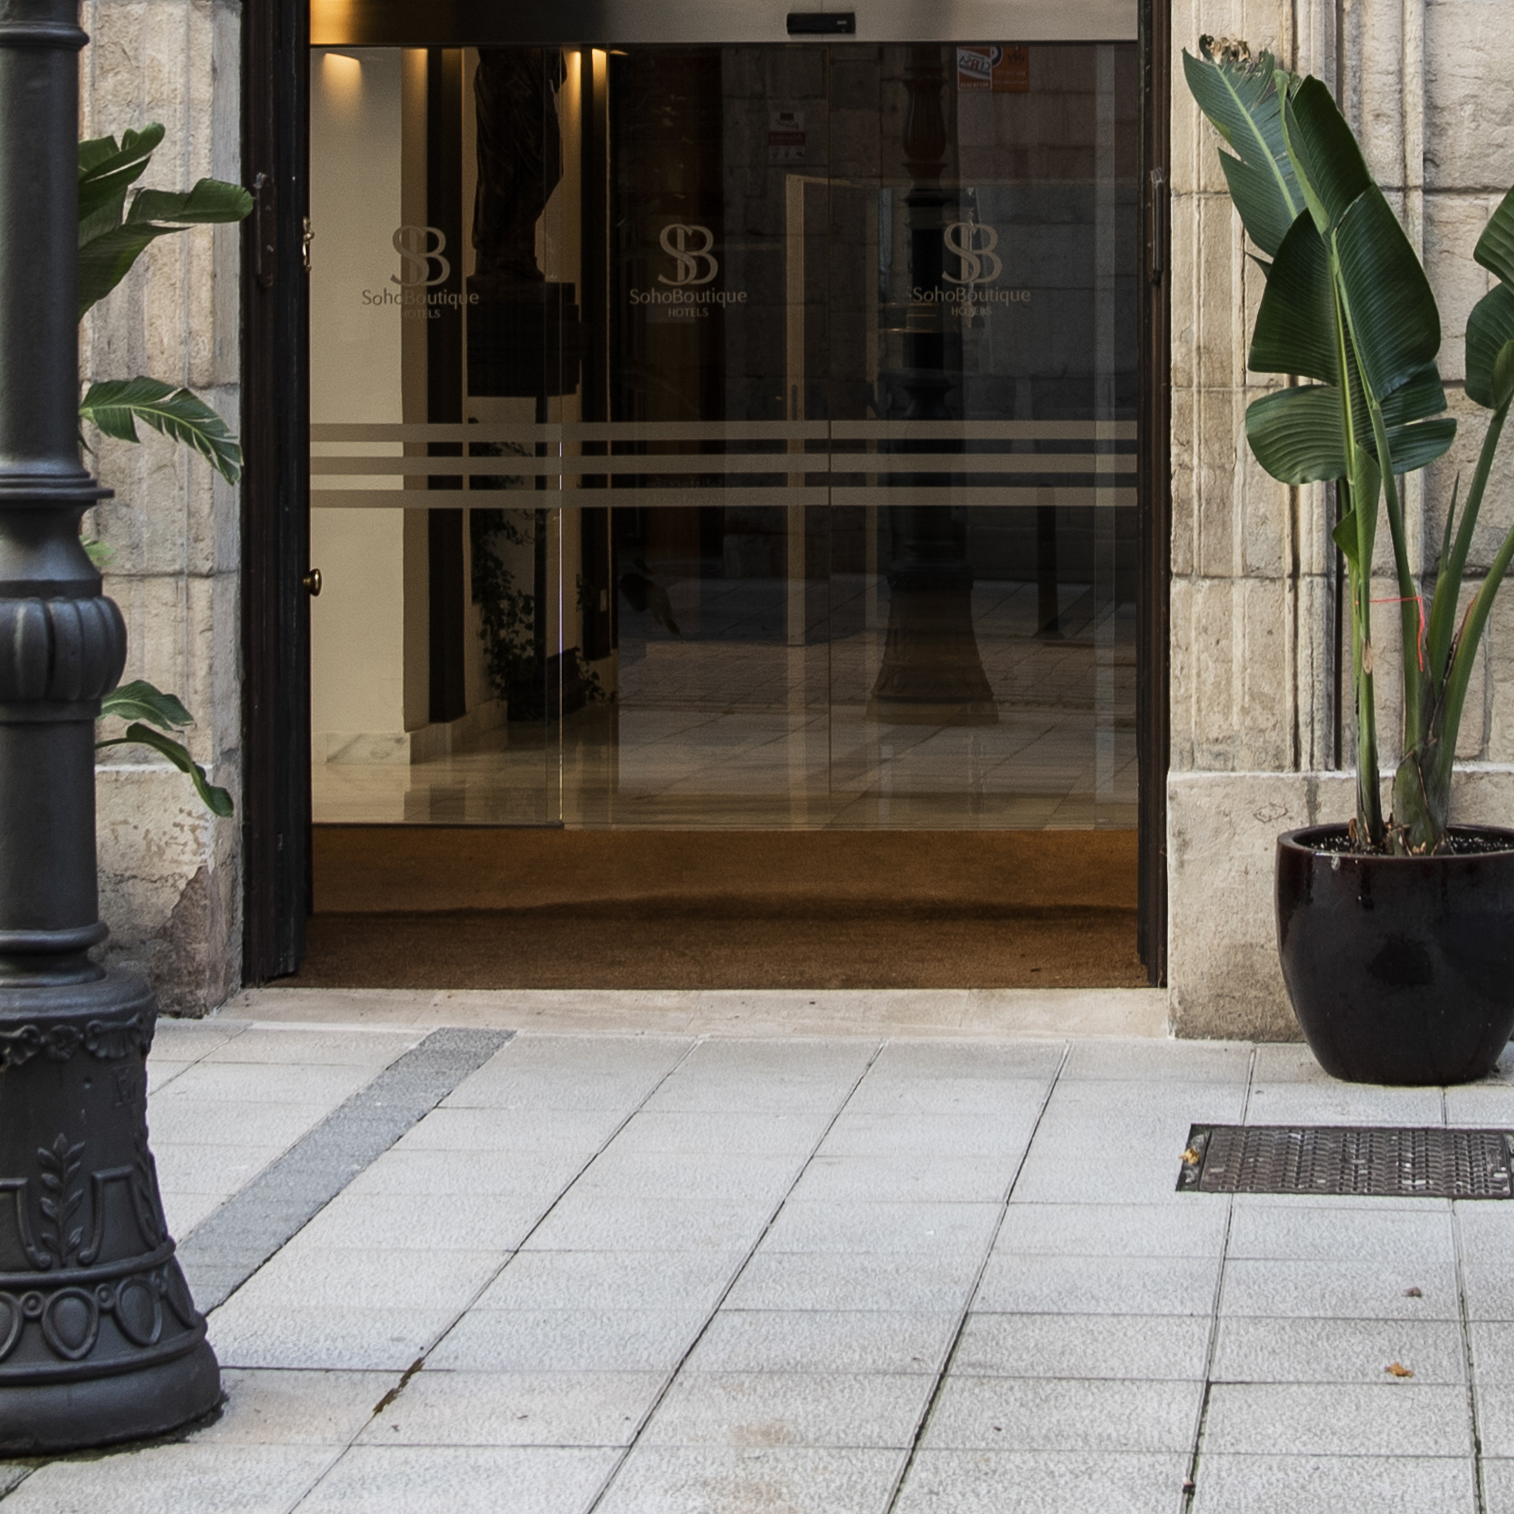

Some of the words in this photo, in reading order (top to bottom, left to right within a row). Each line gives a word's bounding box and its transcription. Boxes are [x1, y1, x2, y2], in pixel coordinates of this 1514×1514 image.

[362, 287, 480, 310] SohoBoutique
[629, 287, 747, 308] SohoBoutique
[912, 286, 1031, 307] SohoBoutique
[668, 307, 709, 318] HOTELS
